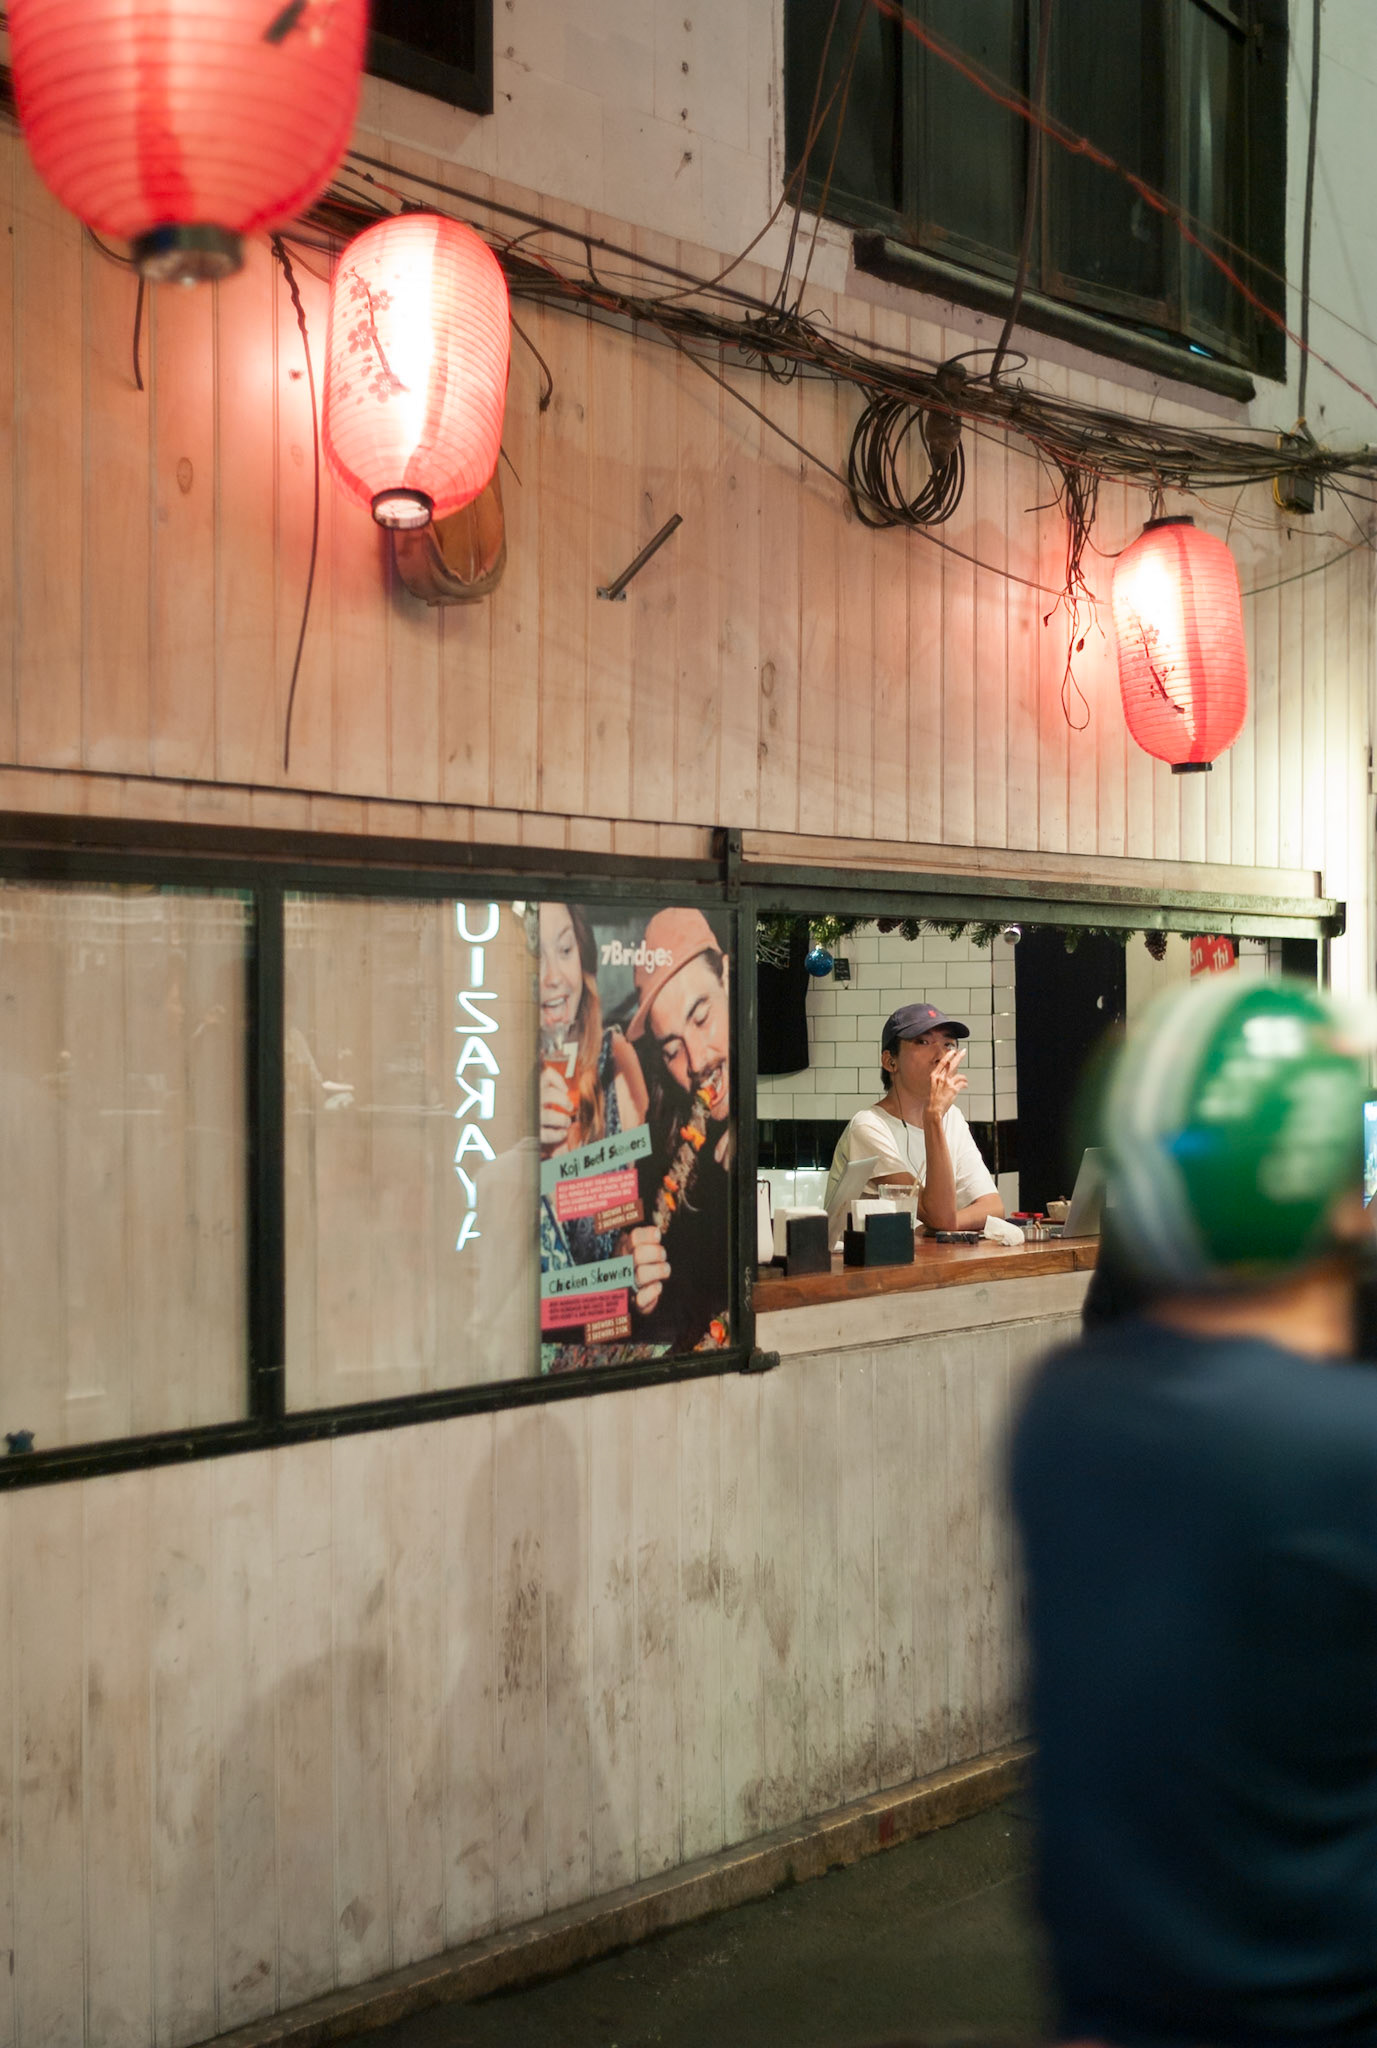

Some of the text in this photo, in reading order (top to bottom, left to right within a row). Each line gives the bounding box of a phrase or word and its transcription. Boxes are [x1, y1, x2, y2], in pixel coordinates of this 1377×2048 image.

[600, 939, 673, 975] 7Bridges
[563, 1041, 579, 1079] 7
[583, 1147, 605, 1169] Beef
[608, 1136, 647, 1160] Skewers
[549, 1265, 632, 1294] Chicken Skewers
